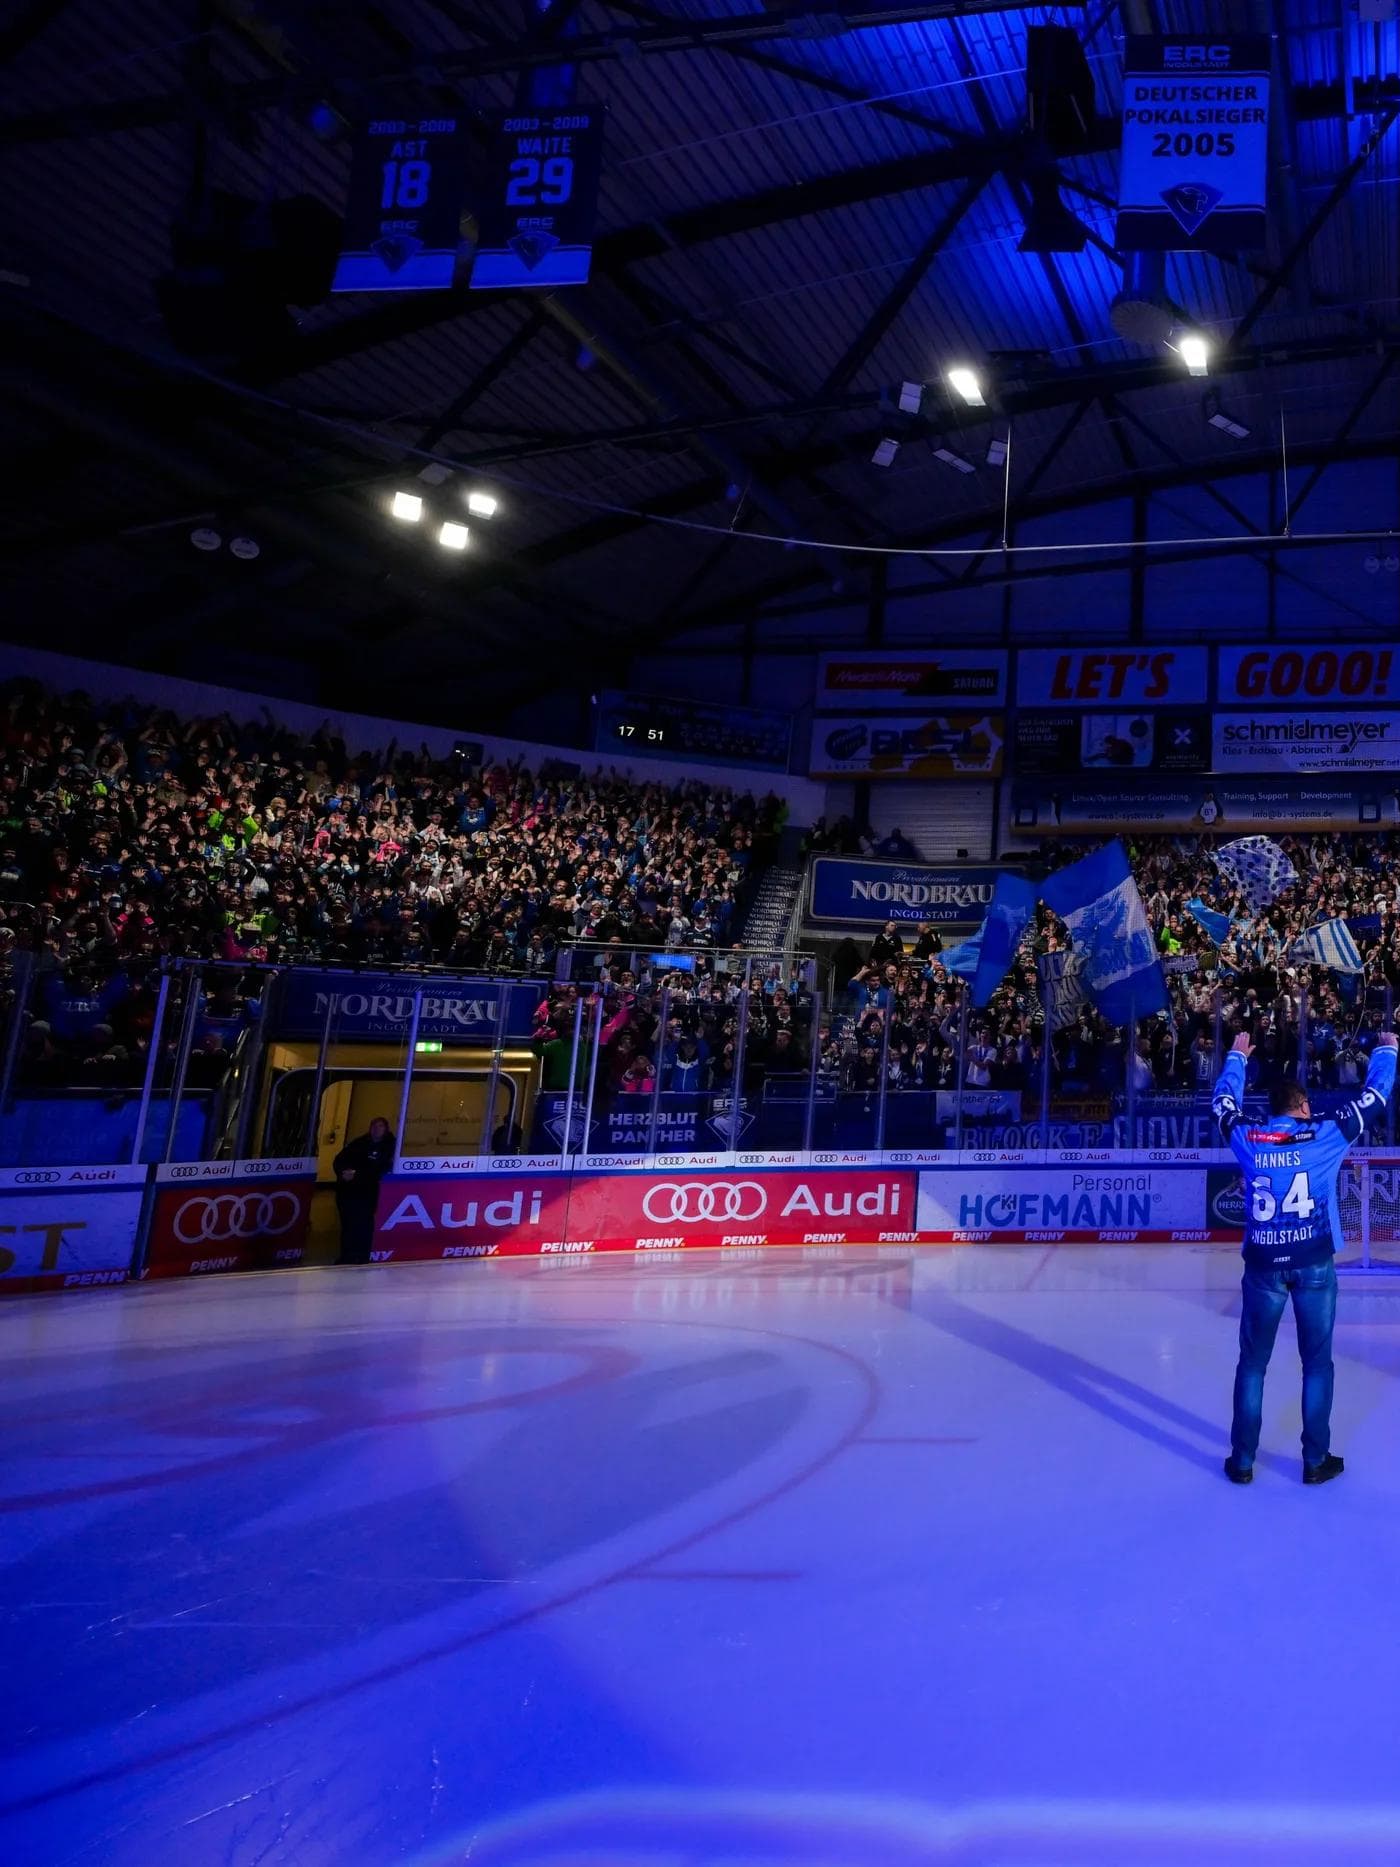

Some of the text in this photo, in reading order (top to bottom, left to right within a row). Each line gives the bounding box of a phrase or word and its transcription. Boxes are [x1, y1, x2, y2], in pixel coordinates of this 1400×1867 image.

[1162, 45, 1232, 62] ERC
[1134, 86, 1257, 102] DEUTSCHER
[1125, 108, 1265, 125] POKALSIEGER
[390, 140, 428, 158] AST
[517, 136, 573, 155] WAITE
[1151, 133, 1236, 157] 2005
[381, 159, 432, 208] 18
[505, 157, 575, 207] 29
[1050, 653, 1176, 699] LET'S
[1235, 650, 1393, 696] GOOO!
[617, 725, 635, 737] 17
[647, 729, 664, 741] 51
[1223, 720, 1390, 747] schmidmeyer
[1290, 743, 1333, 755] Abbruch
[1258, 792, 1289, 802] Support
[1301, 792, 1352, 802] Development
[850, 880, 995, 907] NORDBRÄU
[889, 909, 960, 920] INGOLSTADT
[608, 1111, 698, 1125] HERZBLUT
[611, 1129, 697, 1144] PANTHER
[614, 1157, 644, 1167] Audi
[689, 1156, 718, 1164] Audi
[768, 1155, 795, 1163] Audi
[841, 1154, 867, 1162] Audi
[916, 1153, 941, 1161] Audi
[1000, 1152, 1024, 1161] Audi
[1086, 1152, 1111, 1160] Audi
[1174, 1152, 1201, 1160] Audi
[1254, 1150, 1301, 1169] HANNES
[275, 1162, 303, 1171] Audi
[440, 1160, 475, 1169] Audi
[527, 1159, 558, 1168] Audi
[68, 1169, 117, 1181] Audi
[203, 1164, 231, 1176] Audi
[1072, 1174, 1151, 1191] Personal
[780, 1184, 900, 1217] Audi
[381, 1190, 542, 1231] Audi
[959, 1194, 1150, 1227] HOFMANN
[721, 1235, 768, 1245] PENNY
[803, 1233, 846, 1243] PENNY
[878, 1232, 919, 1242] PENNY
[952, 1231, 992, 1241] PENNY
[1024, 1231, 1065, 1241] PENNY
[1099, 1231, 1138, 1241] PENNY
[1171, 1231, 1211, 1241] PENNY
[541, 1241, 594, 1252] PENNY
[636, 1237, 683, 1248] PENNY
[442, 1245, 498, 1257] PENNY
[190, 1256, 238, 1272] PENNY
